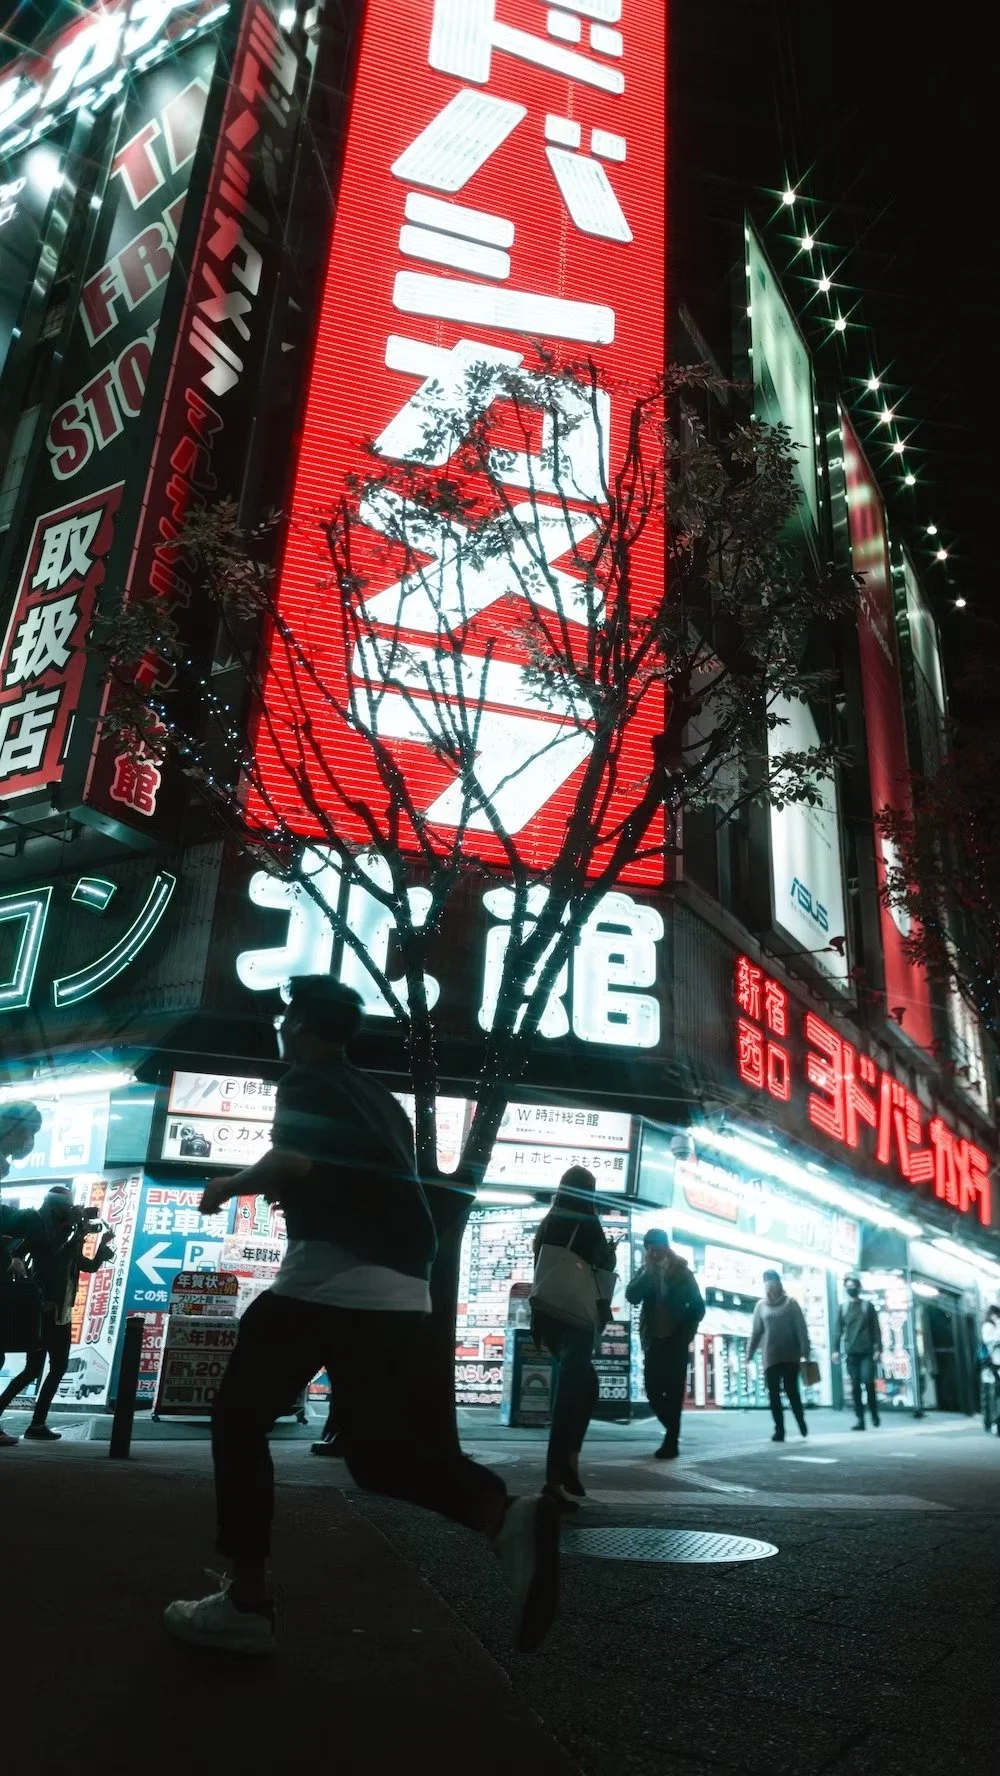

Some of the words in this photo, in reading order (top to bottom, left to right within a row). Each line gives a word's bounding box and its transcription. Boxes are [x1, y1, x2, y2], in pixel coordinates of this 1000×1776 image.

[79, 191, 188, 348] FR
[347, 0, 634, 835] ドバシカメラ
[0, 507, 105, 780] 取扱店
[790, 876, 830, 933] ASUS
[735, 954, 788, 1038] 新宿
[243, 1080, 276, 1097] 修理
[536, 1108, 600, 1127] 時計総合館
[142, 1206, 229, 1238] 駐車場
[243, 1247, 281, 1263] 年賀状
[133, 1289, 168, 1303] この先
[177, 1273, 219, 1289] 年賀状
